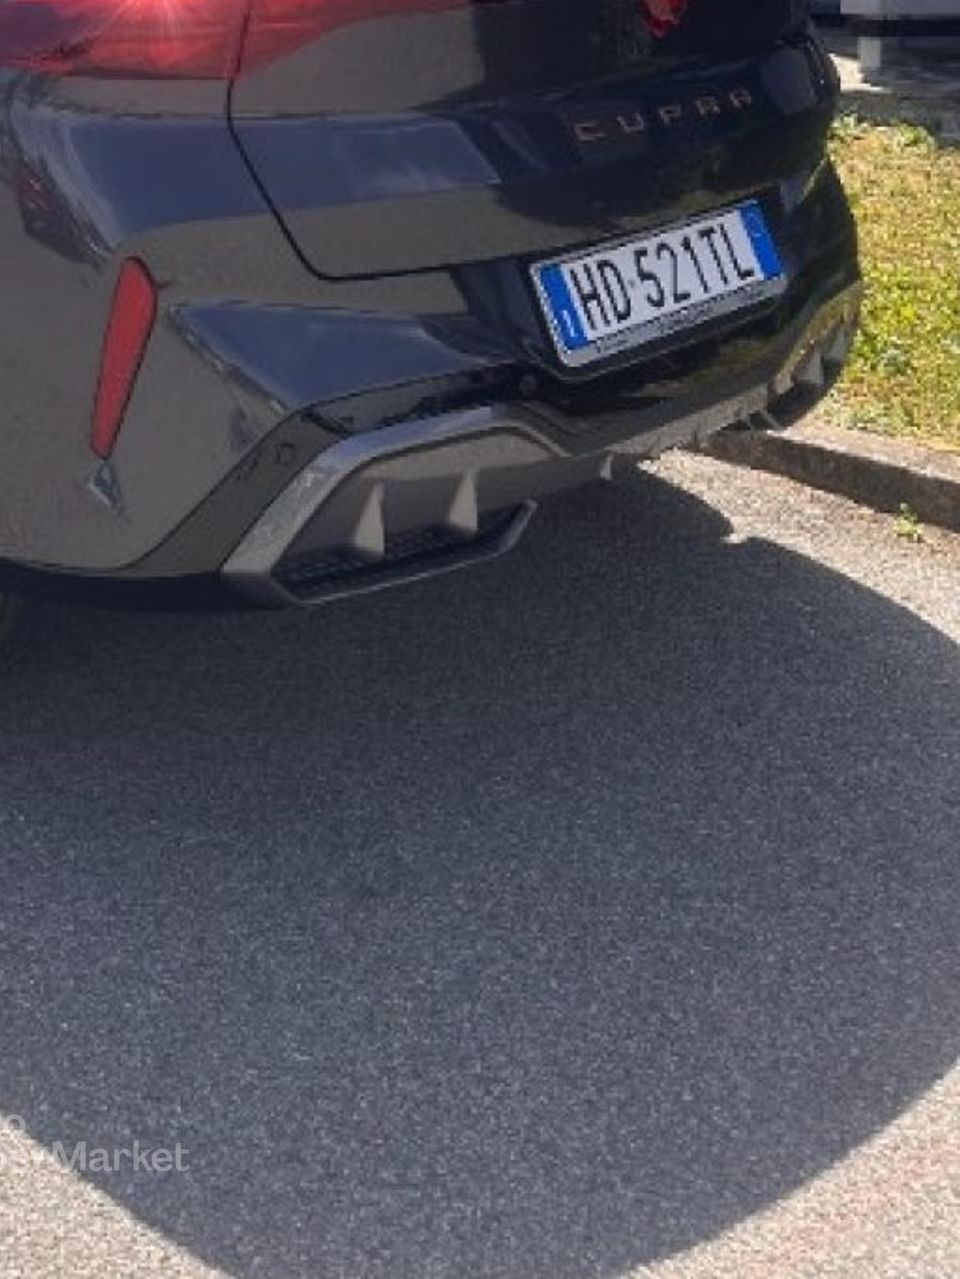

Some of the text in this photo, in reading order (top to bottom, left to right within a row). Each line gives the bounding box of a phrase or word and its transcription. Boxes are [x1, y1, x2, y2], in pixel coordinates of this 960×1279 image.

[574, 88, 752, 141] CUPRA
[570, 259, 632, 330] HD
[634, 223, 755, 307] 521TL
